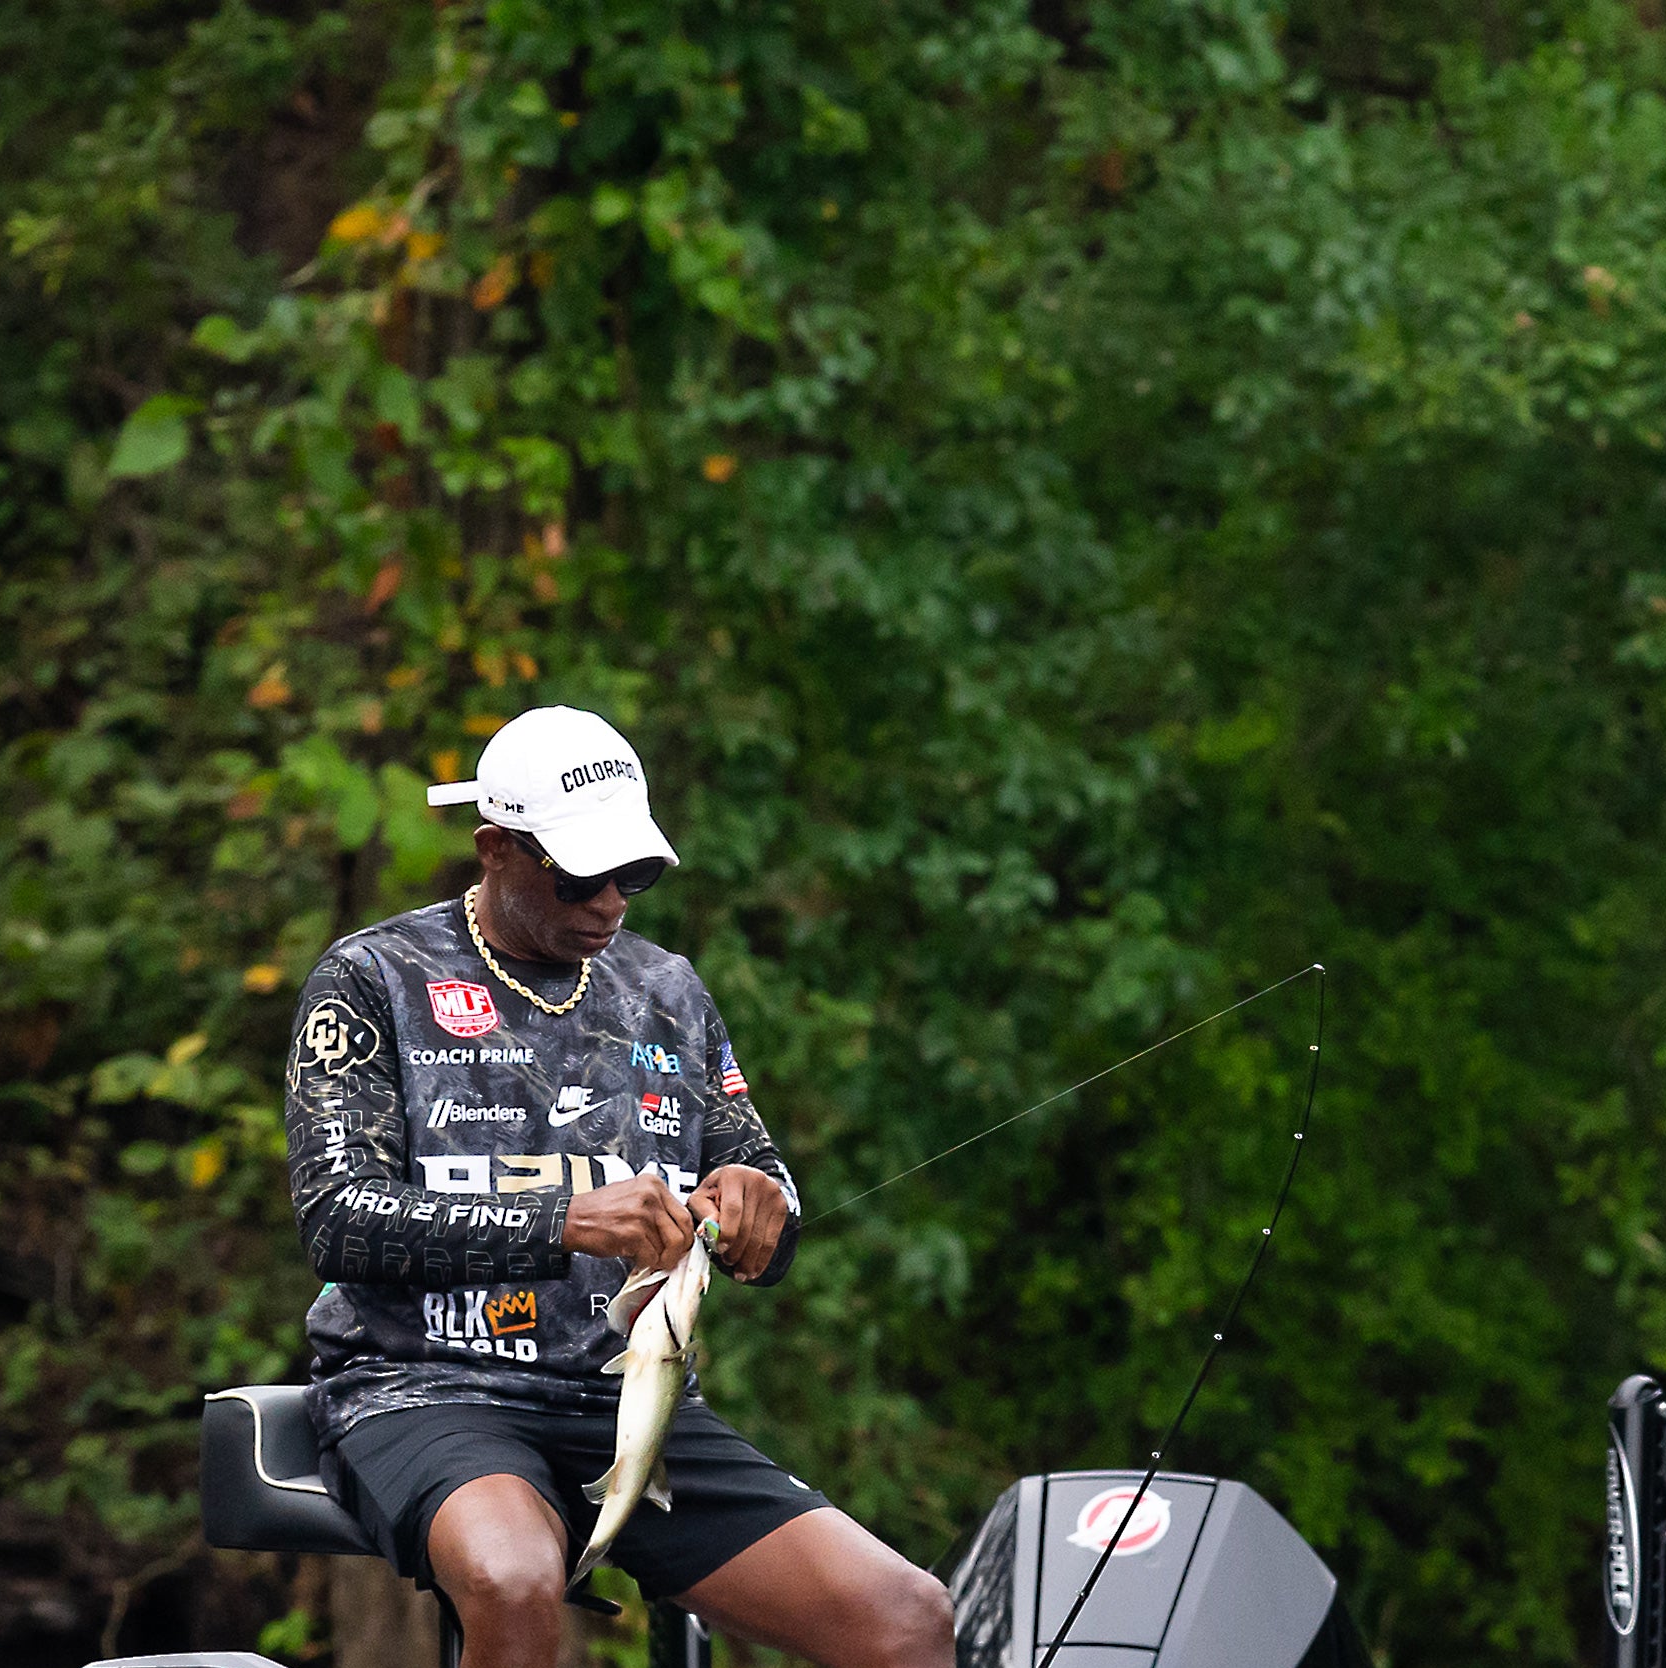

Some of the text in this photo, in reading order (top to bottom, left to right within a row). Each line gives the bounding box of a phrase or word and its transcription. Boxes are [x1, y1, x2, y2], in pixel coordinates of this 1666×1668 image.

[488, 796, 525, 814] PME
[434, 989, 488, 1017] MLF
[306, 1009, 349, 1059] CU
[409, 1048, 534, 1066] COACH PRIME
[556, 1085, 594, 1110] NIE
[449, 1103, 528, 1122] Blenders
[411, 1201, 437, 1222] 2
[448, 1203, 530, 1229] FIND
[424, 1289, 489, 1339] BLK
[447, 1338, 539, 1363] OLD
